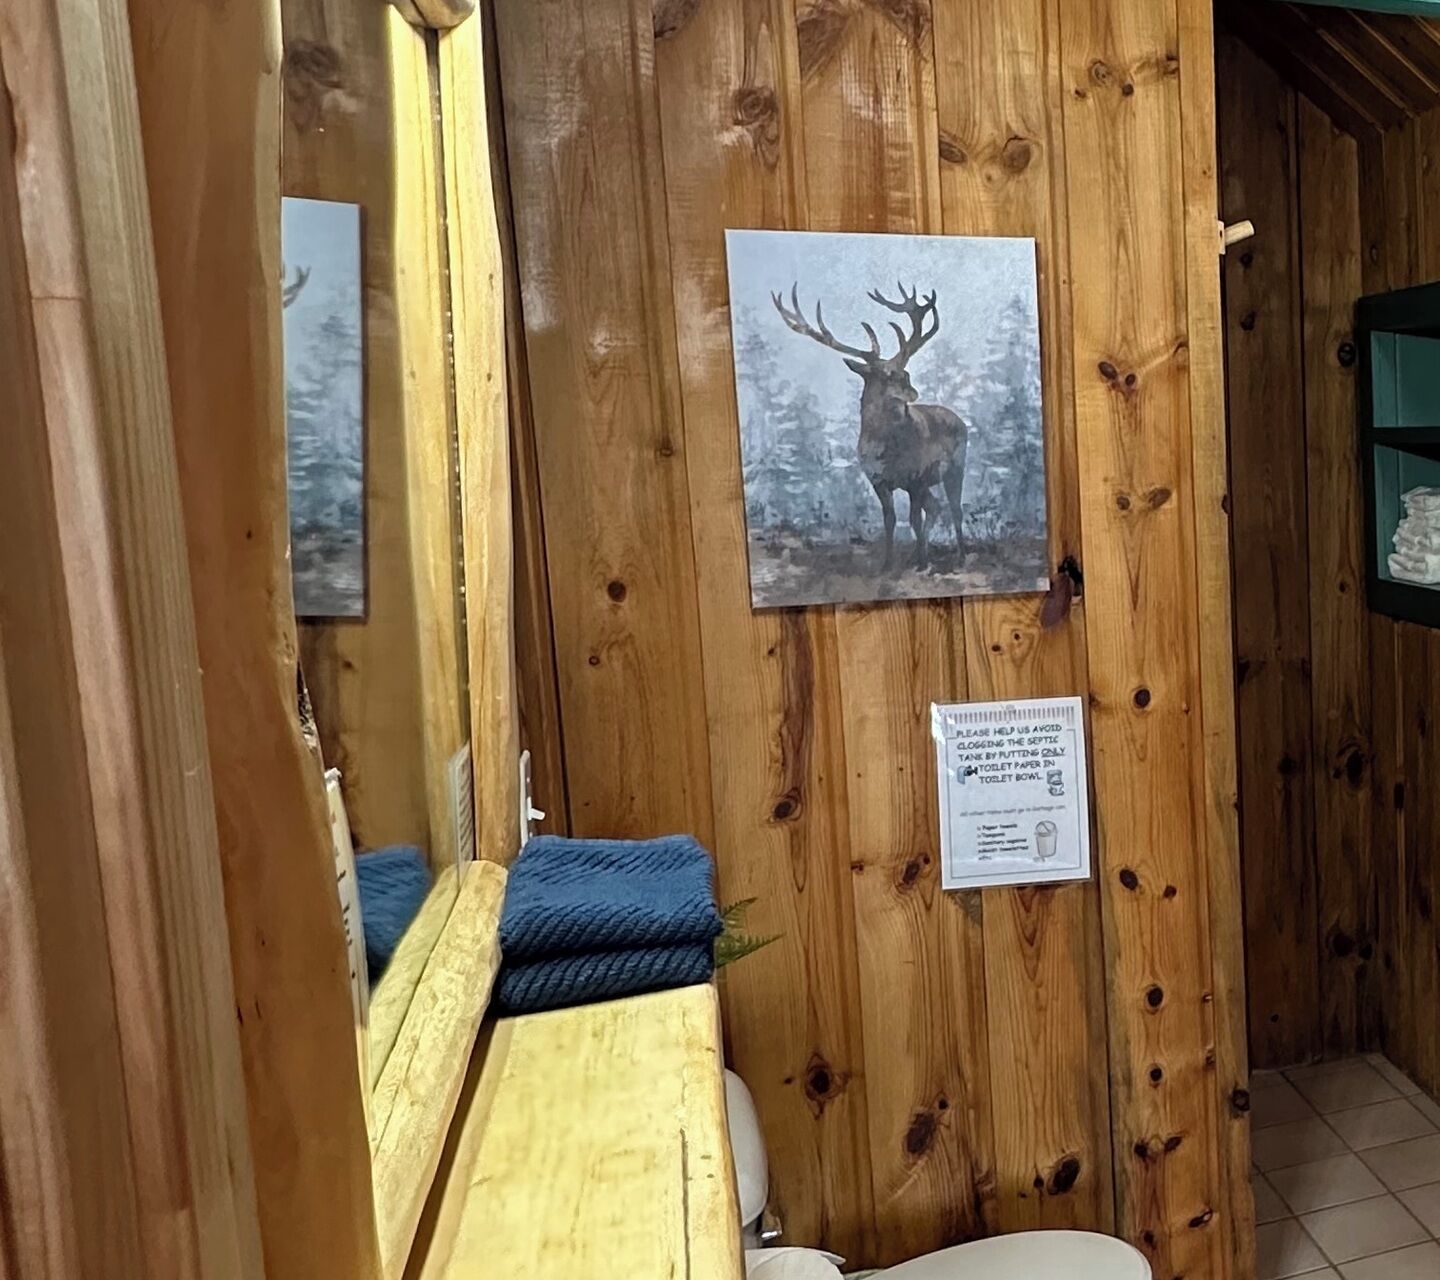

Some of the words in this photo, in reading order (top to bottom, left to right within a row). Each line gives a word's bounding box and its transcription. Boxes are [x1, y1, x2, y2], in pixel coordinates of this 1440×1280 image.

[956, 728, 990, 738] PLEASE
[993, 726, 1015, 736] HELP
[1017, 725, 1030, 734] US
[1032, 723, 1062, 733] AVOID
[956, 739, 1005, 750] CLOGGING
[1007, 737, 1025, 747] THE
[1027, 735, 1059, 746] SEPTIC
[958, 752, 983, 762] TANK
[985, 751, 997, 761] BY
[998, 749, 1040, 759] PUTTING
[1041, 746, 1066, 757] ONLY
[978, 762, 1012, 772] TOILET
[1014, 760, 1041, 769] PAPER
[1043, 759, 1056, 768] IN
[978, 774, 1013, 784] TOILET
